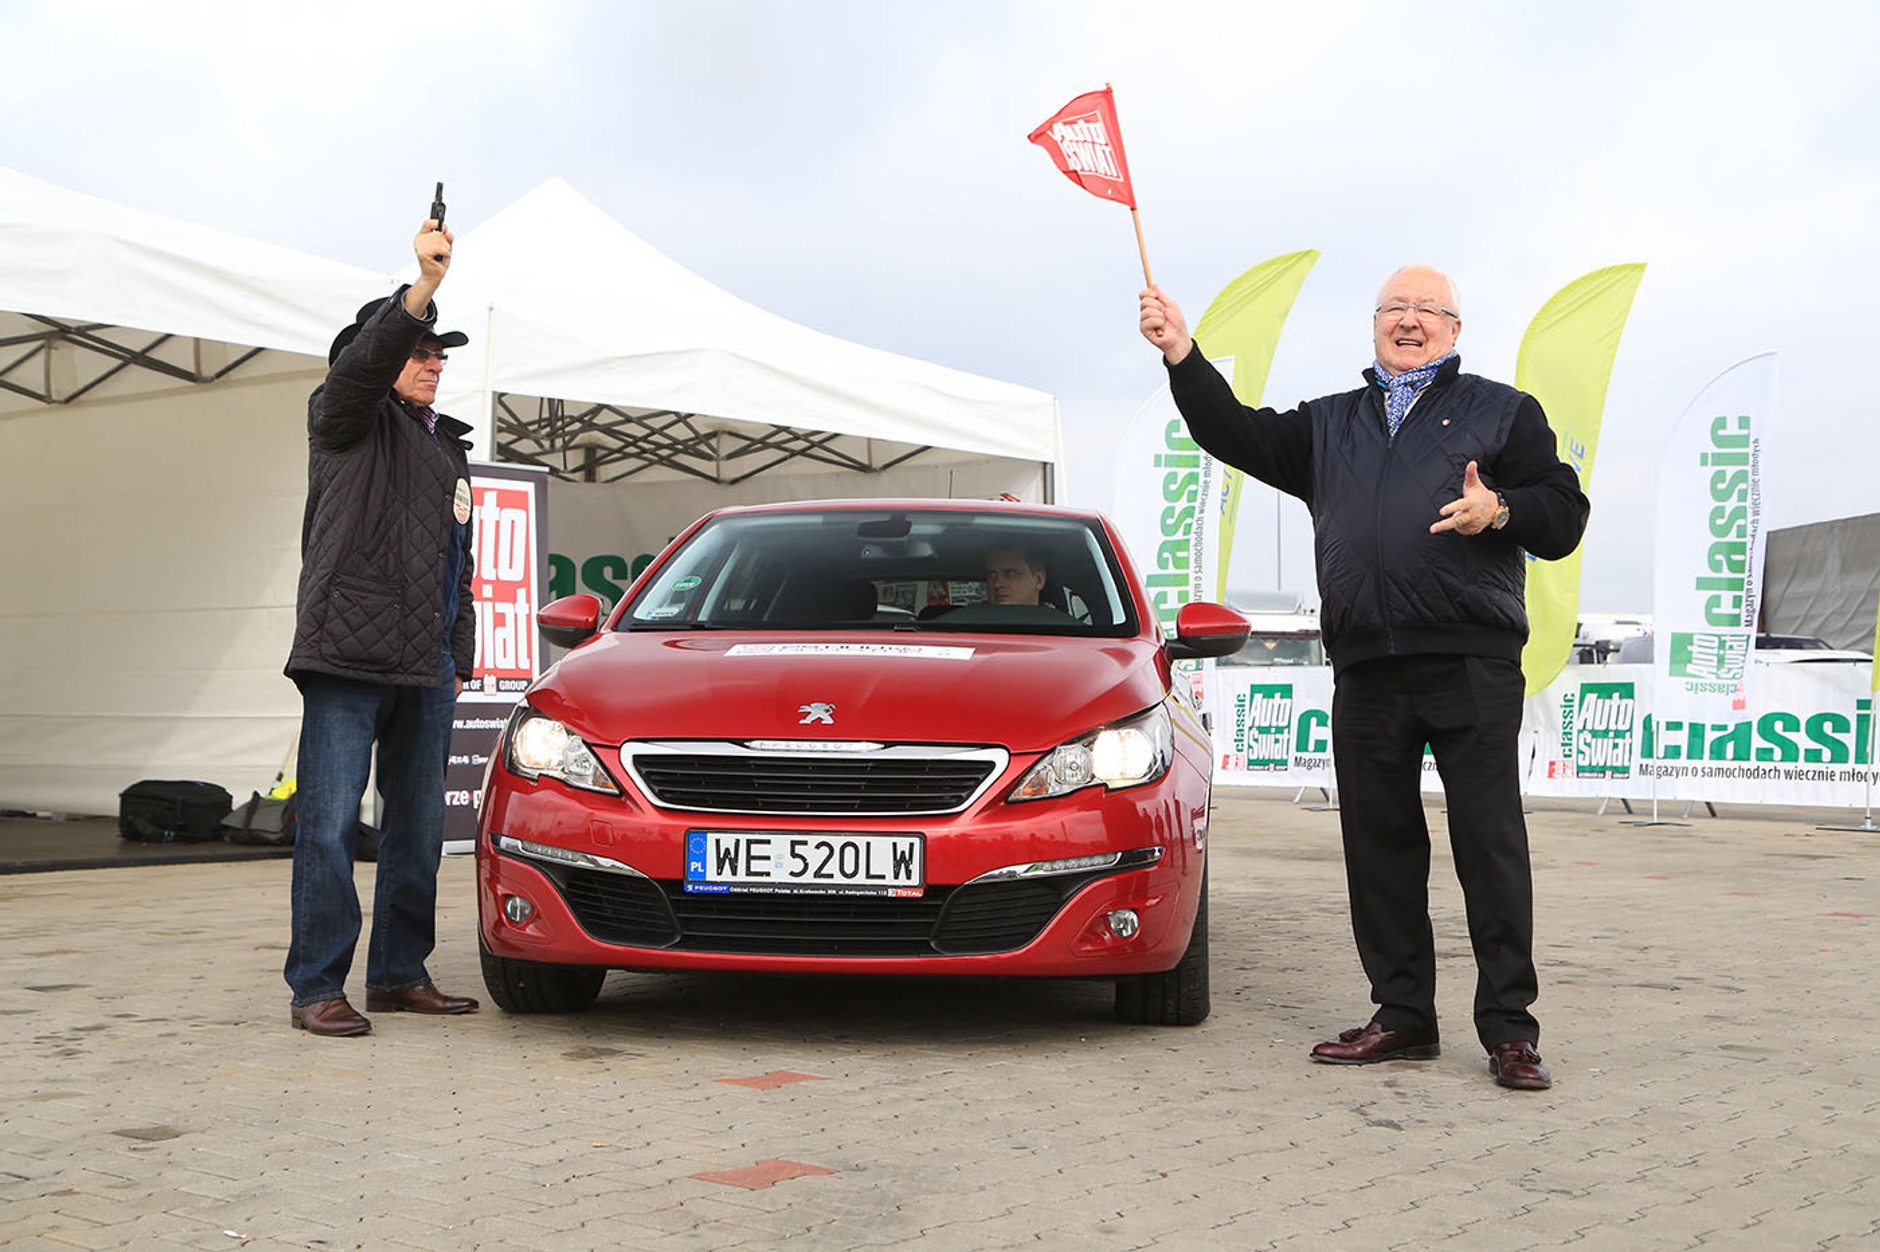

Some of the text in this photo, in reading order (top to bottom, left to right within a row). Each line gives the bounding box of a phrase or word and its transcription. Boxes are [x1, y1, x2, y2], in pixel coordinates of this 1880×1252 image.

[1193, 516, 1204, 574] samochodach
[1202, 454, 1213, 478] młod
[1696, 416, 1750, 627] classic
[1686, 633, 1719, 679] Auto
[470, 679, 481, 690] OF
[499, 681, 528, 691] GROUP
[1234, 693, 1246, 753] classic
[1249, 692, 1293, 728] Auto
[1560, 692, 1575, 758] classic
[1577, 691, 1635, 732] Auto
[1641, 699, 1879, 764] classi
[1639, 763, 1689, 779] Magazyn
[1691, 767, 1698, 777] o
[1700, 765, 1781, 780] samochodach
[1784, 768, 1836, 782] wiecznie
[1838, 769, 1880, 786] młody
[445, 790, 468, 806] rze
[690, 838, 914, 880] PL WE 520LW
